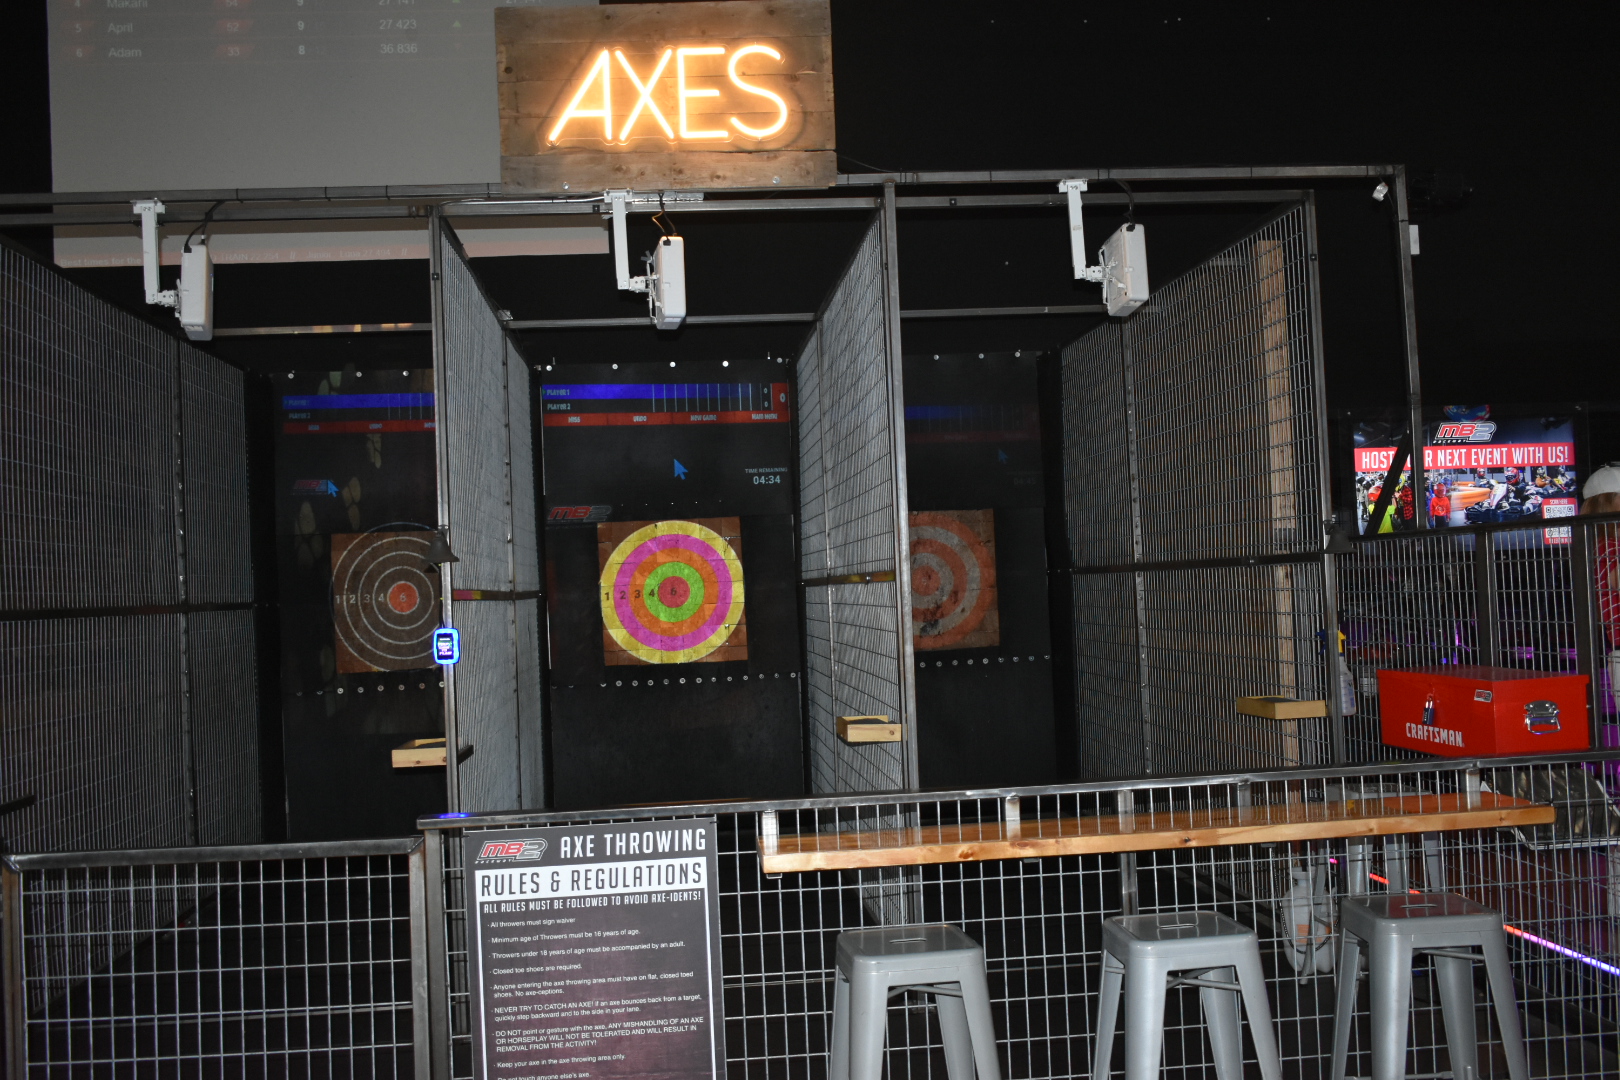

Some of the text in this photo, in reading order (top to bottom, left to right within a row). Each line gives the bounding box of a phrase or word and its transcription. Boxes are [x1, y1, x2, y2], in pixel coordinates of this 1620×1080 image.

[75, 23, 83, 34] 5
[107, 22, 134, 36] April
[296, 20, 305, 31] 9
[75, 47, 83, 58] 6
[107, 47, 143, 58] Adam
[226, 46, 241, 57] 33
[298, 44, 306, 56] 8
[547, 44, 789, 142] AXES
[60, 256, 142, 267] Best times for the
[779, 392, 787, 403] 0
[547, 403, 567, 411] PLAYER
[632, 415, 648, 423] UNDO
[690, 414, 703, 422] NEW
[1436, 421, 1497, 442] MB2
[1361, 450, 1395, 469] HOST
[1437, 448, 1467, 466] NEXT
[1471, 447, 1507, 466] EVENT
[1512, 446, 1544, 465] WITH
[1548, 445, 1569, 464] US!
[758, 466, 788, 474] REMAINING
[752, 474, 782, 485] 04:34
[547, 505, 613, 523] MB2
[335, 592, 407, 604] 1 2 3 4 6
[604, 587, 678, 601] 1 2 3 4 6
[1405, 722, 1463, 748] CRAFTSMAN
[479, 839, 547, 862] MB2
[560, 828, 706, 859] AXE THROWING
[481, 861, 702, 897] RULES & REGULATIONS
[484, 890, 702, 914] ALL RULES MUST BE FOLLOWED TO AVOID AXE-IDENTS!
[499, 920, 526, 928] throwers
[542, 918, 556, 926] sign
[602, 930, 620, 938] years
[521, 950, 539, 958] under
[548, 949, 566, 957] years
[611, 942, 651, 952] accompanied
[651, 942, 660, 950] by
[669, 940, 686, 948] adult.
[492, 967, 514, 975] Closed
[556, 963, 582, 972] required.
[565, 978, 592, 986] throwing
[659, 972, 680, 980] closed
[494, 1006, 518, 1014] NEVER
[543, 1002, 567, 1011] CATCH
[621, 998, 647, 1006] bounces
[494, 1014, 516, 1023] quickly
[530, 1011, 560, 1019] backward
[611, 1007, 626, 1015] your
[522, 1028, 538, 1036] point
[546, 1027, 569, 1035] gesture
[622, 1018, 669, 1028] MISHANDLING
[690, 1016, 704, 1024] AXE
[507, 1034, 548, 1044] HORSEPLAY
[548, 1032, 565, 1041] WILL
[565, 1032, 580, 1040] NOT
[591, 1029, 631, 1038] TOLERATED
[663, 1025, 689, 1033] RESULT
[496, 1039, 597, 1053] REMOVAL FROM THE ACTIVITY!
[514, 1061, 528, 1069] your
